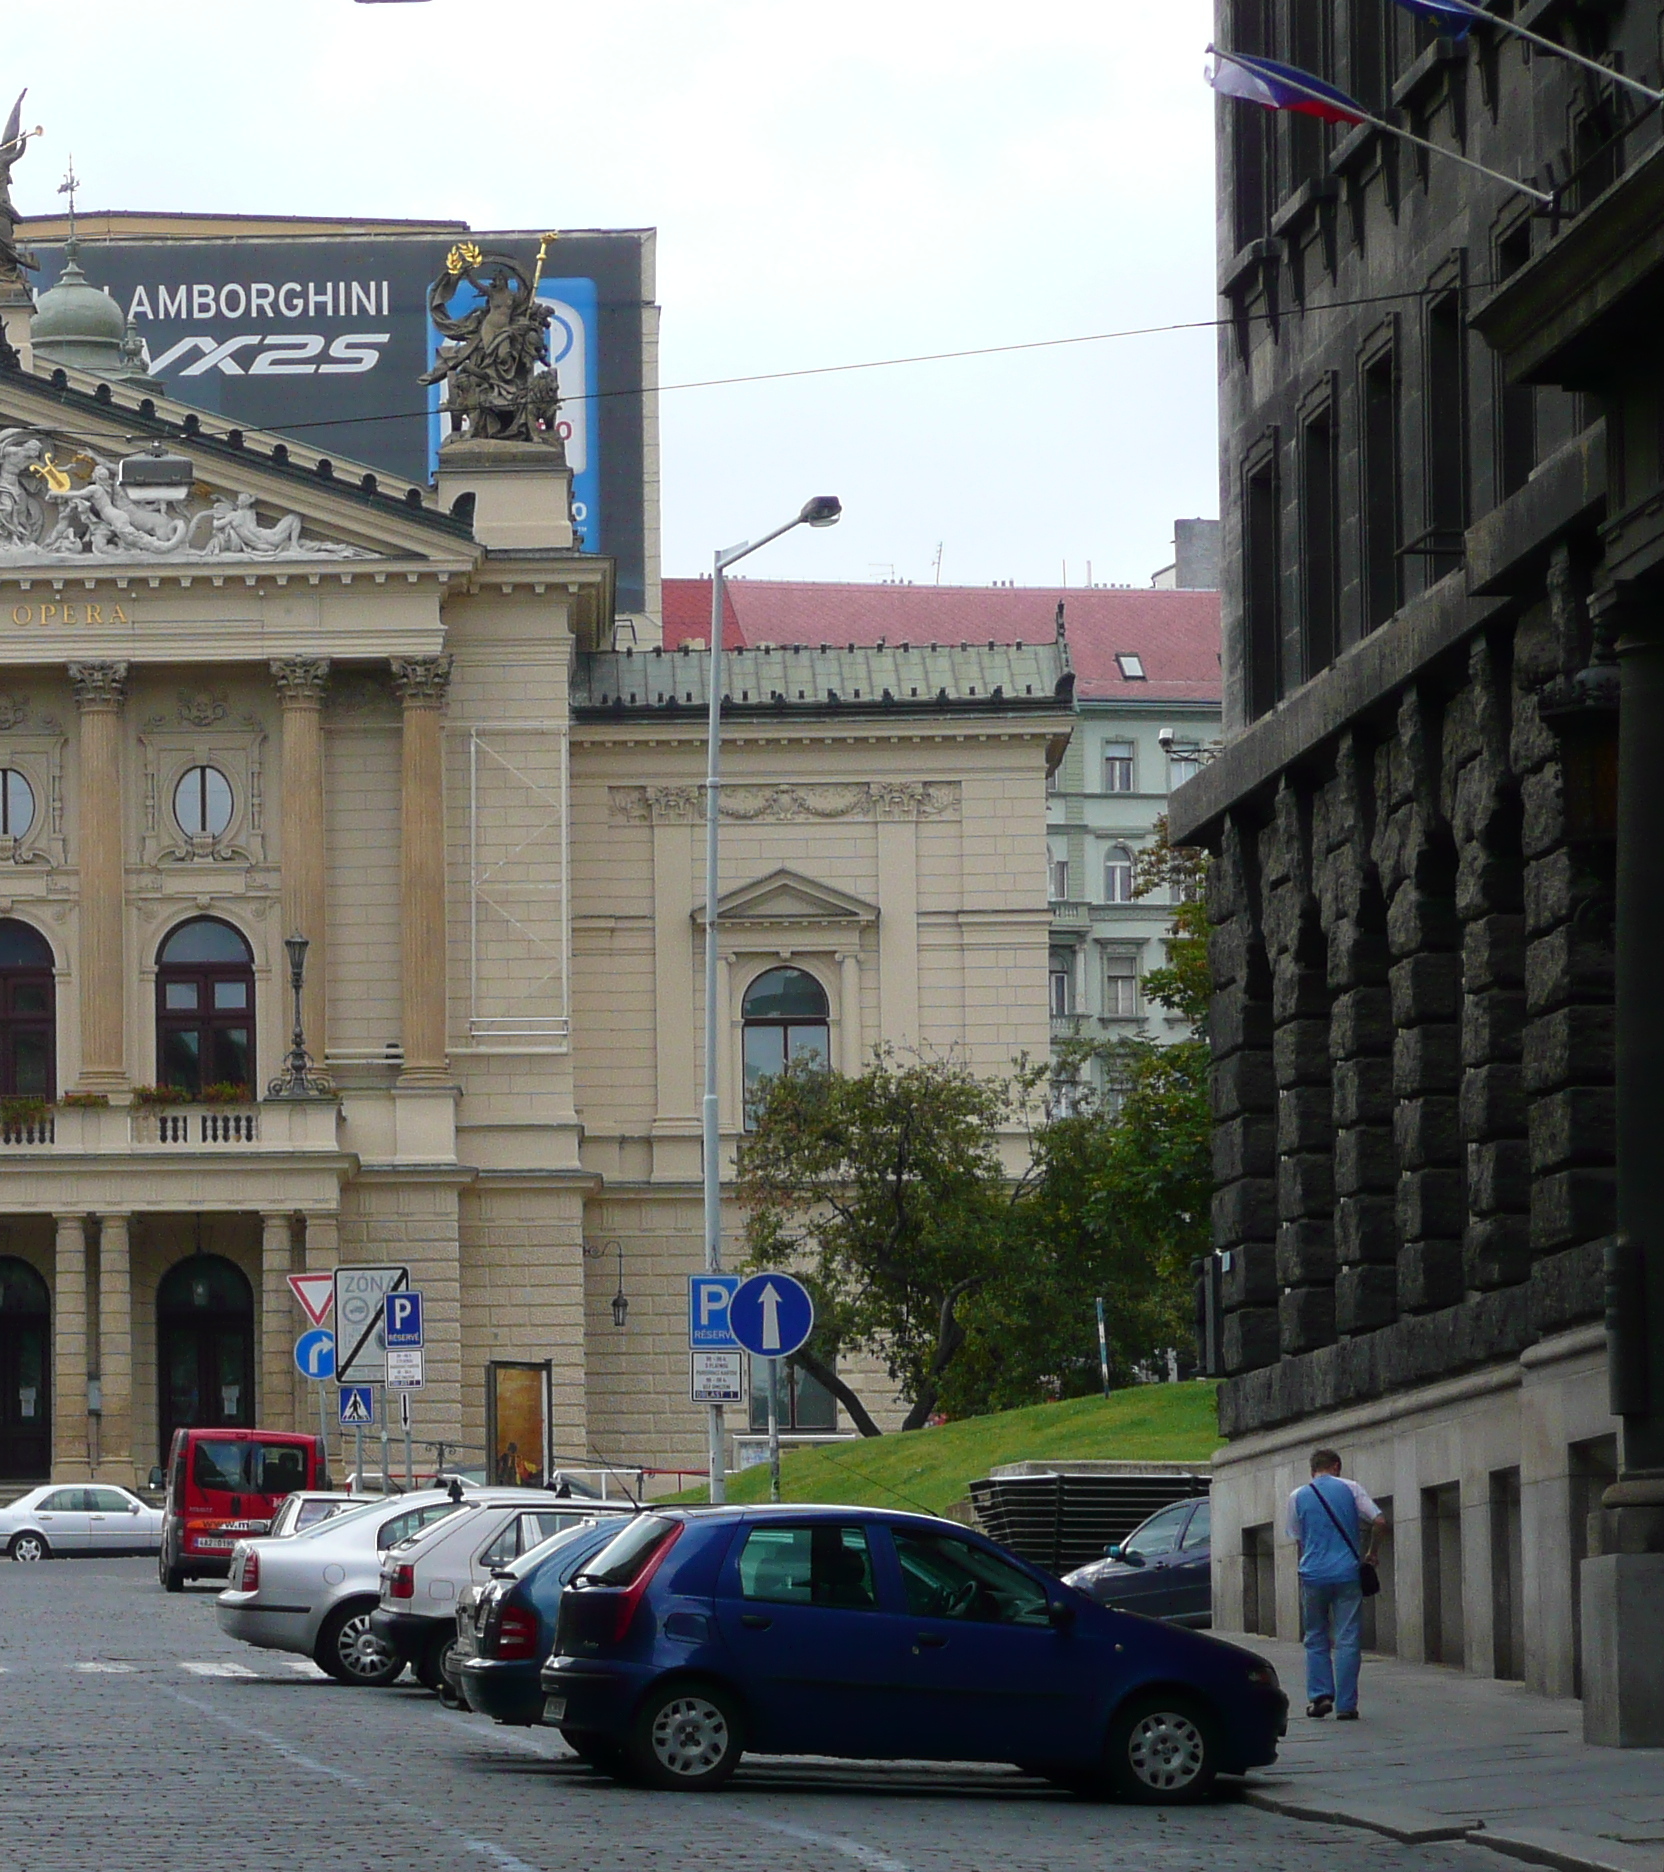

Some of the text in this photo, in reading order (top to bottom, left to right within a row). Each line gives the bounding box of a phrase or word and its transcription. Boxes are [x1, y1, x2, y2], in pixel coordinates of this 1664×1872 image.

[103, 281, 390, 320] AMBORGHINI
[12, 603, 128, 626] OPERA
[394, 1298, 412, 1329] P
[700, 1284, 730, 1325] P
